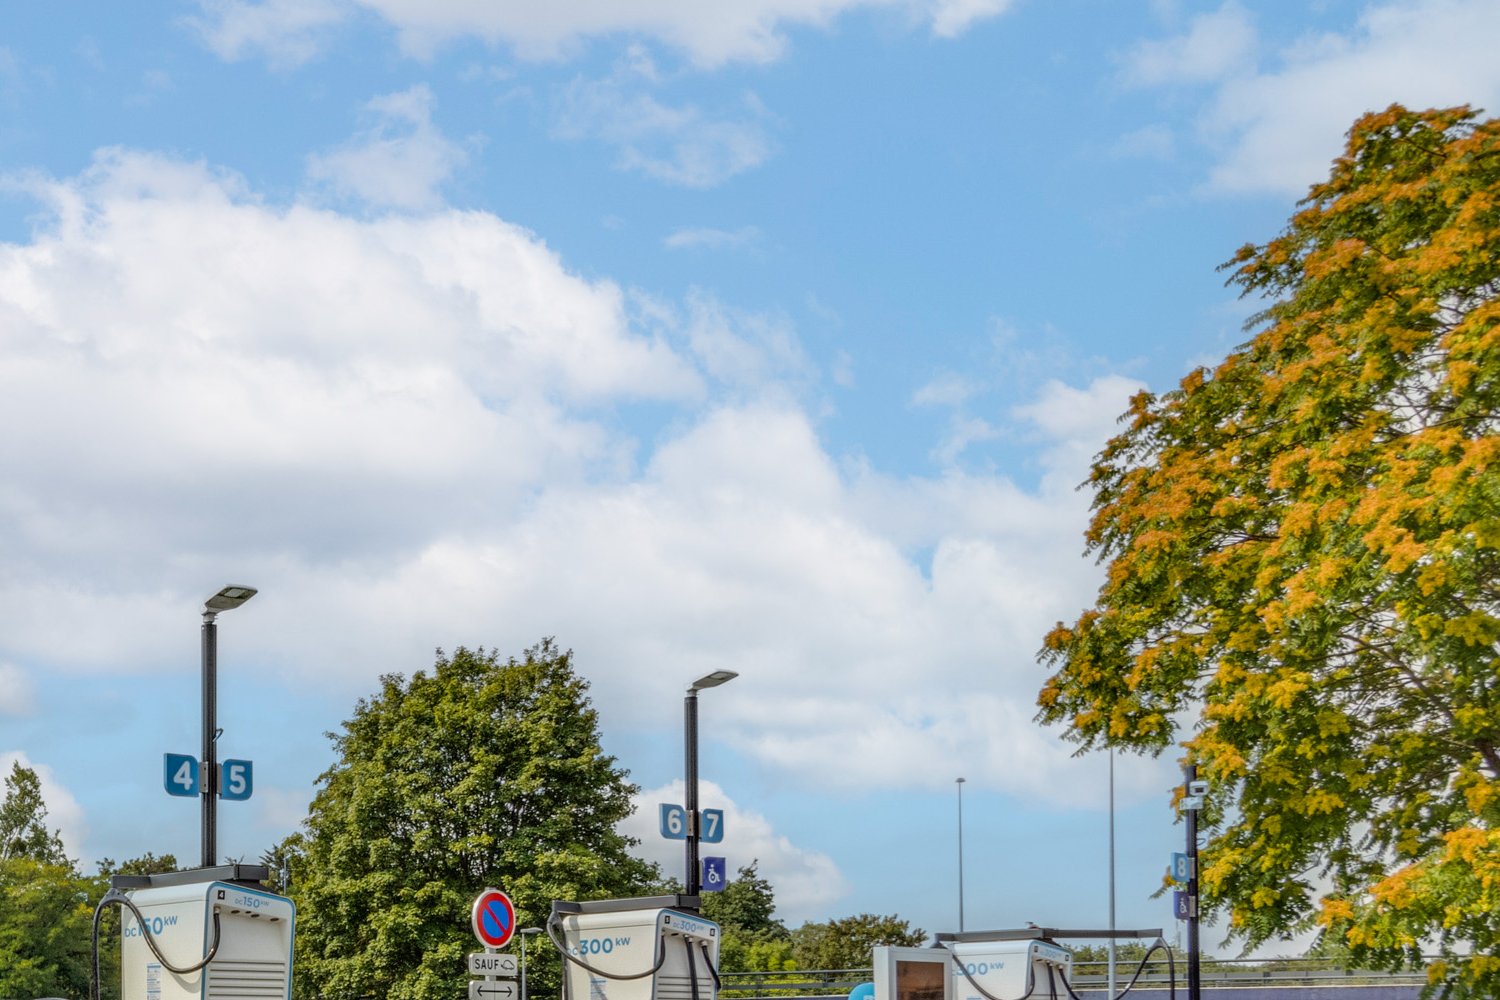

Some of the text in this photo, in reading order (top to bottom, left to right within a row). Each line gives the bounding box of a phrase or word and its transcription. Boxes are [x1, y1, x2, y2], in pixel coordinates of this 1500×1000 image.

[173, 760, 194, 791] 4
[229, 765, 247, 794] 5
[667, 809, 682, 835] 6
[706, 813, 719, 838] 7
[1177, 857, 1187, 877] 8
[243, 896, 260, 908] 150
[124, 927, 137, 938] DC
[164, 915, 179, 927] kW
[680, 920, 697, 933] 300
[580, 938, 614, 956] 300
[615, 937, 631, 947] kW
[474, 958, 500, 970] SAUF
